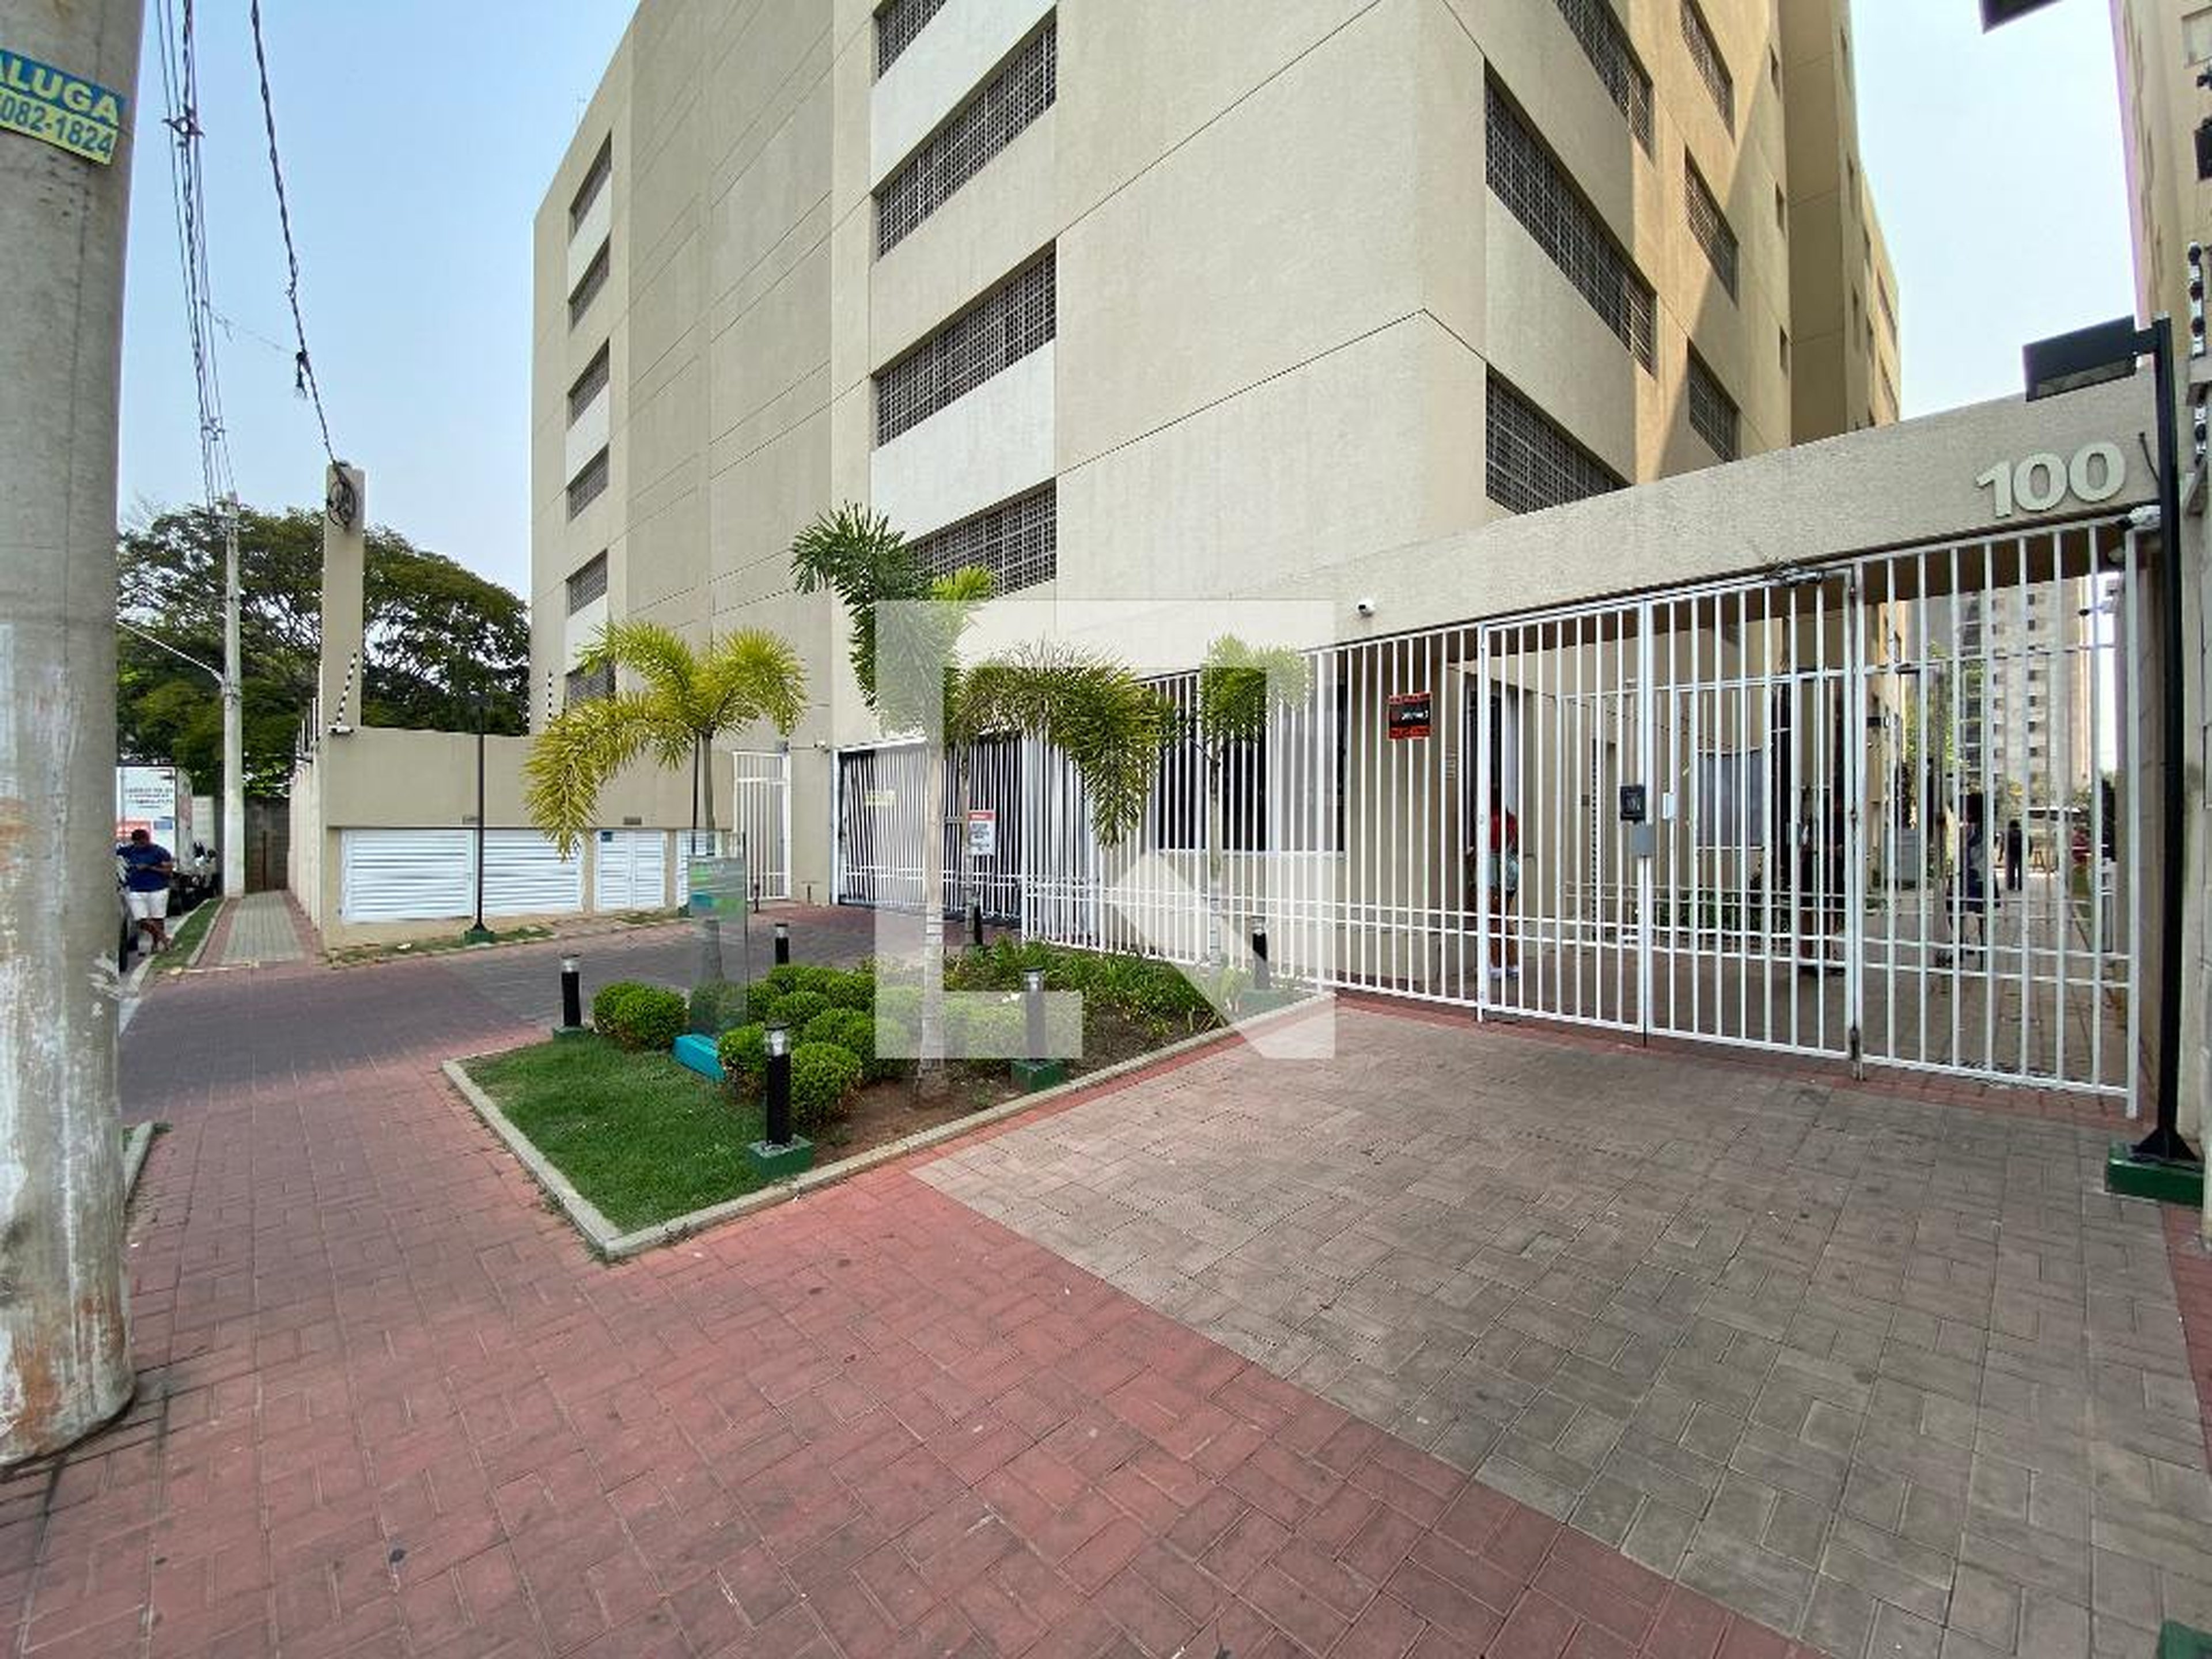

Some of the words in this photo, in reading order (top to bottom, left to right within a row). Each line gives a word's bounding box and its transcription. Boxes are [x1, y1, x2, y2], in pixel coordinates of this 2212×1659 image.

[0, 54, 118, 125] LUGA
[0, 94, 113, 157] 082-1824
[1975, 442, 2126, 518] 100
